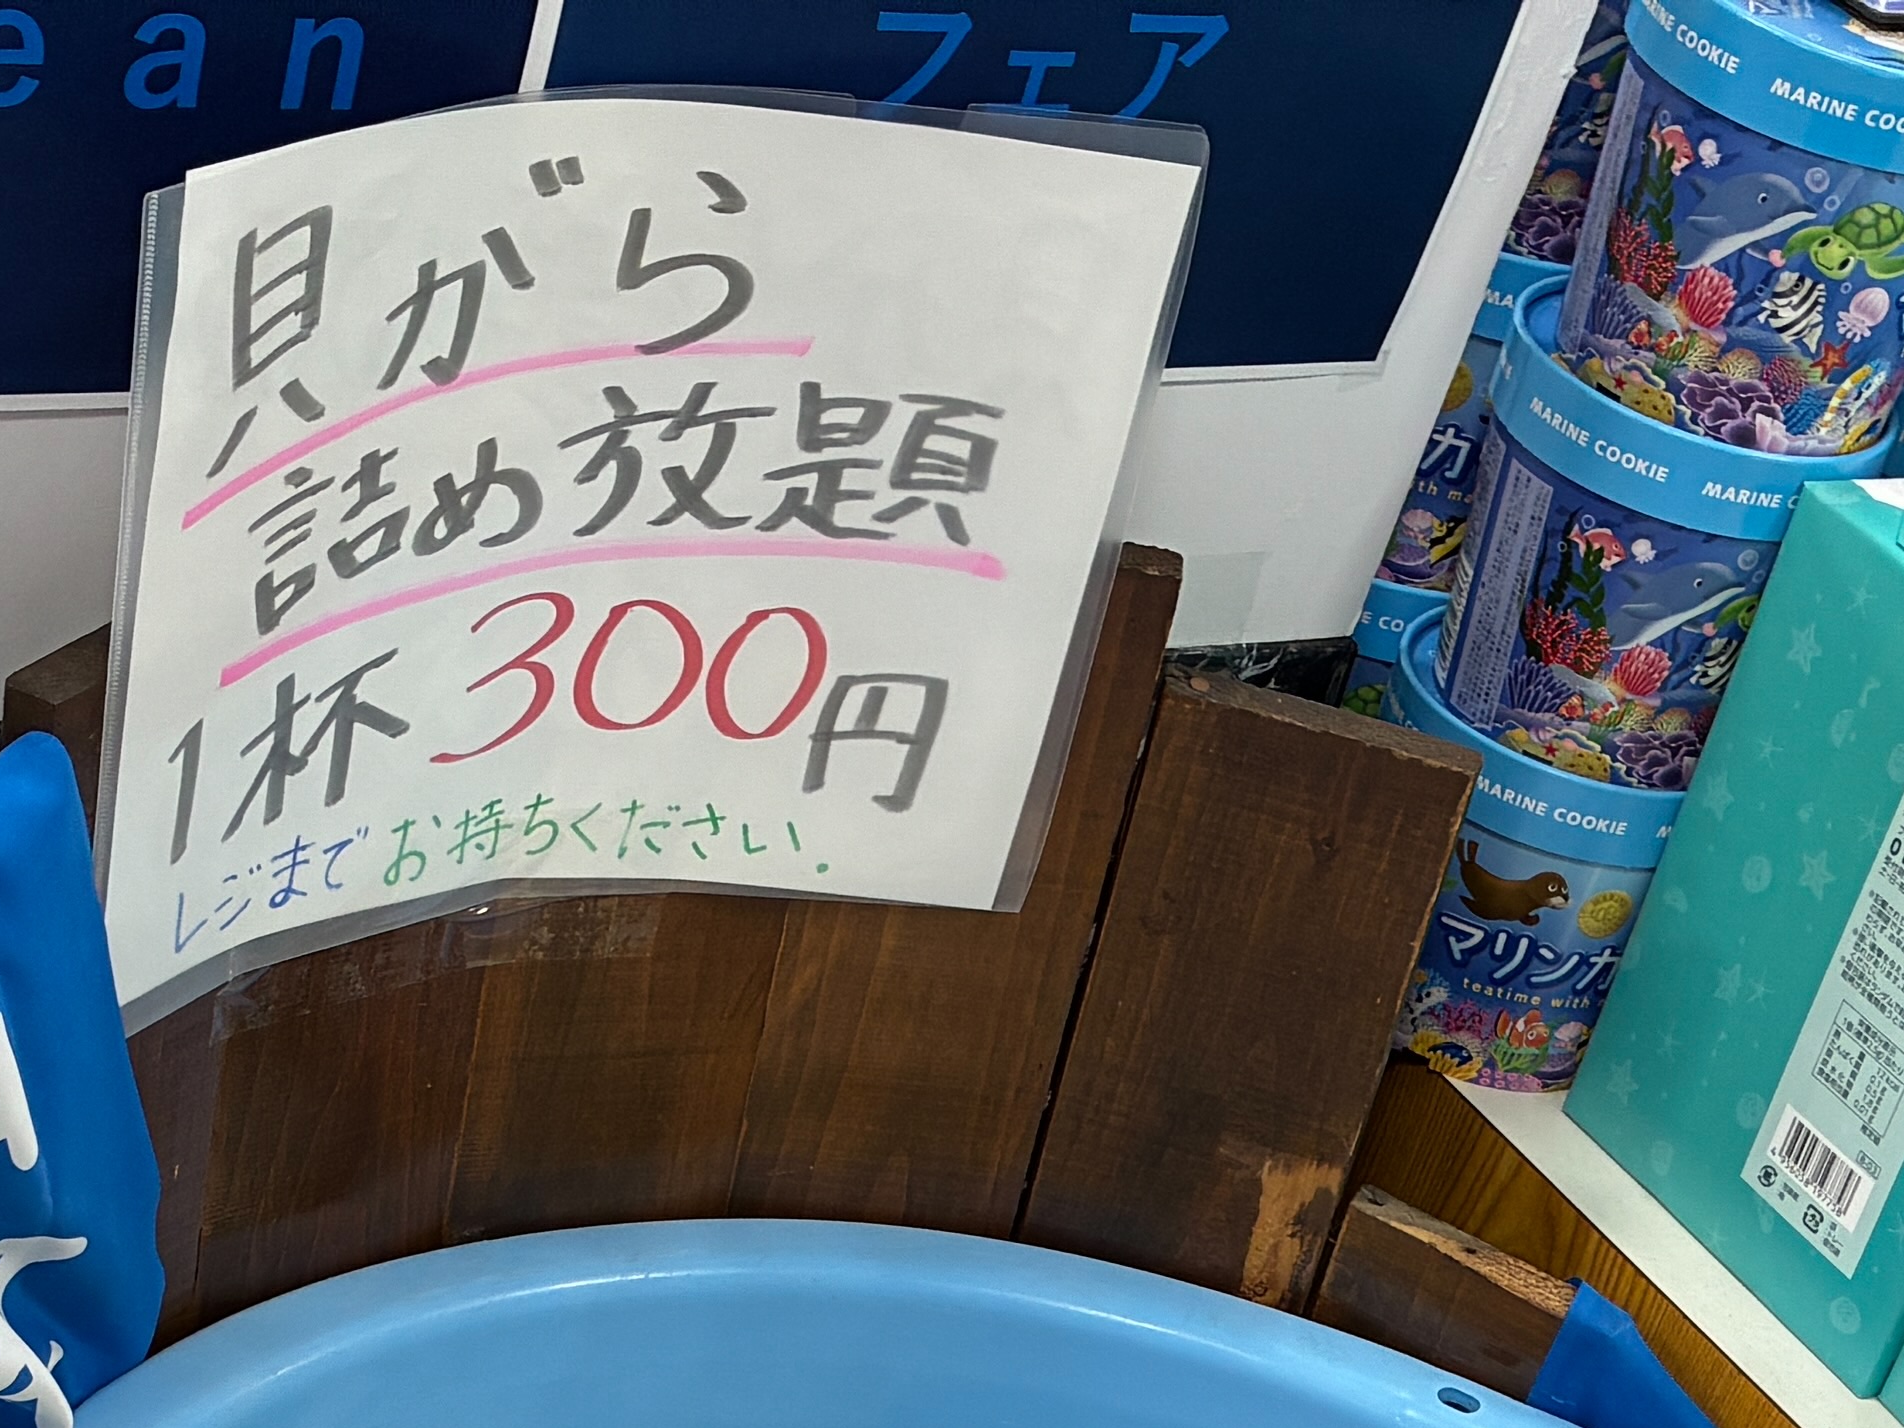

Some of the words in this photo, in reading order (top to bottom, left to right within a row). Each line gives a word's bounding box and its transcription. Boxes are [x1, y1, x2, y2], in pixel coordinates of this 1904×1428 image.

[874, 12, 1229, 118] フェア
[1675, 24, 1741, 75] COOKIE
[1769, 77, 1859, 122] MARINE
[204, 156, 750, 482] 貝がら
[1528, 397, 1590, 448] MARINE
[1594, 439, 1670, 485] COOKIE
[248, 380, 1004, 635] 詰め放題
[1701, 480, 1774, 511] MARINE
[1477, 774, 1549, 817] MARINE
[1552, 807, 1629, 837] COOKIE
